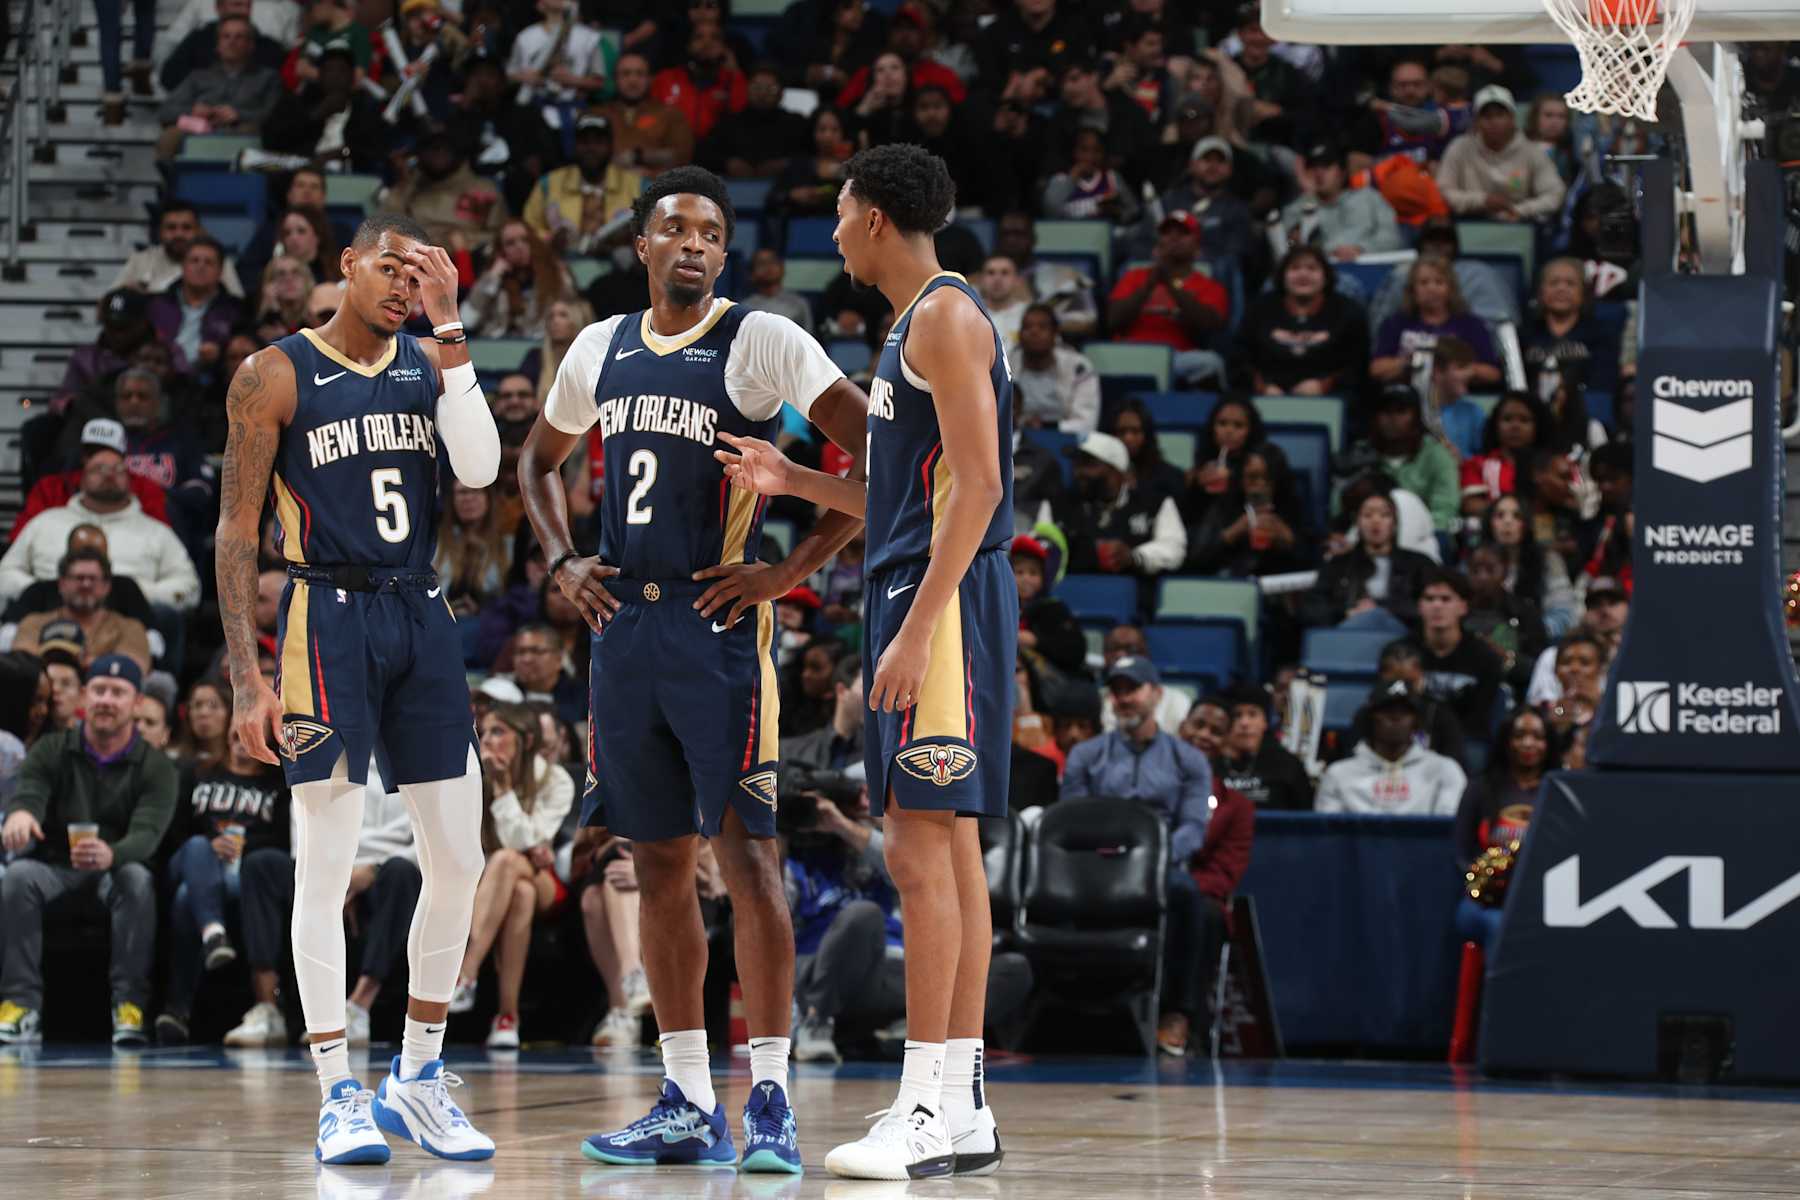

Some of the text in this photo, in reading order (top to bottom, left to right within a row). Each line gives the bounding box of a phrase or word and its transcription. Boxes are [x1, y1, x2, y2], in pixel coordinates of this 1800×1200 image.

[682, 348, 718, 357] NEWAGE
[388, 367, 423, 377] NEWAGE
[1653, 375, 1754, 398] Chevron
[632, 394, 719, 447] ORLEANS
[307, 417, 359, 469] NEW
[626, 448, 658, 525] 2
[370, 467, 411, 544] 5
[1645, 524, 1755, 547] NEWAGE
[1653, 551, 1743, 565] PRODUCTS
[1677, 681, 1783, 707] Keesler
[1677, 708, 1781, 734] Federal
